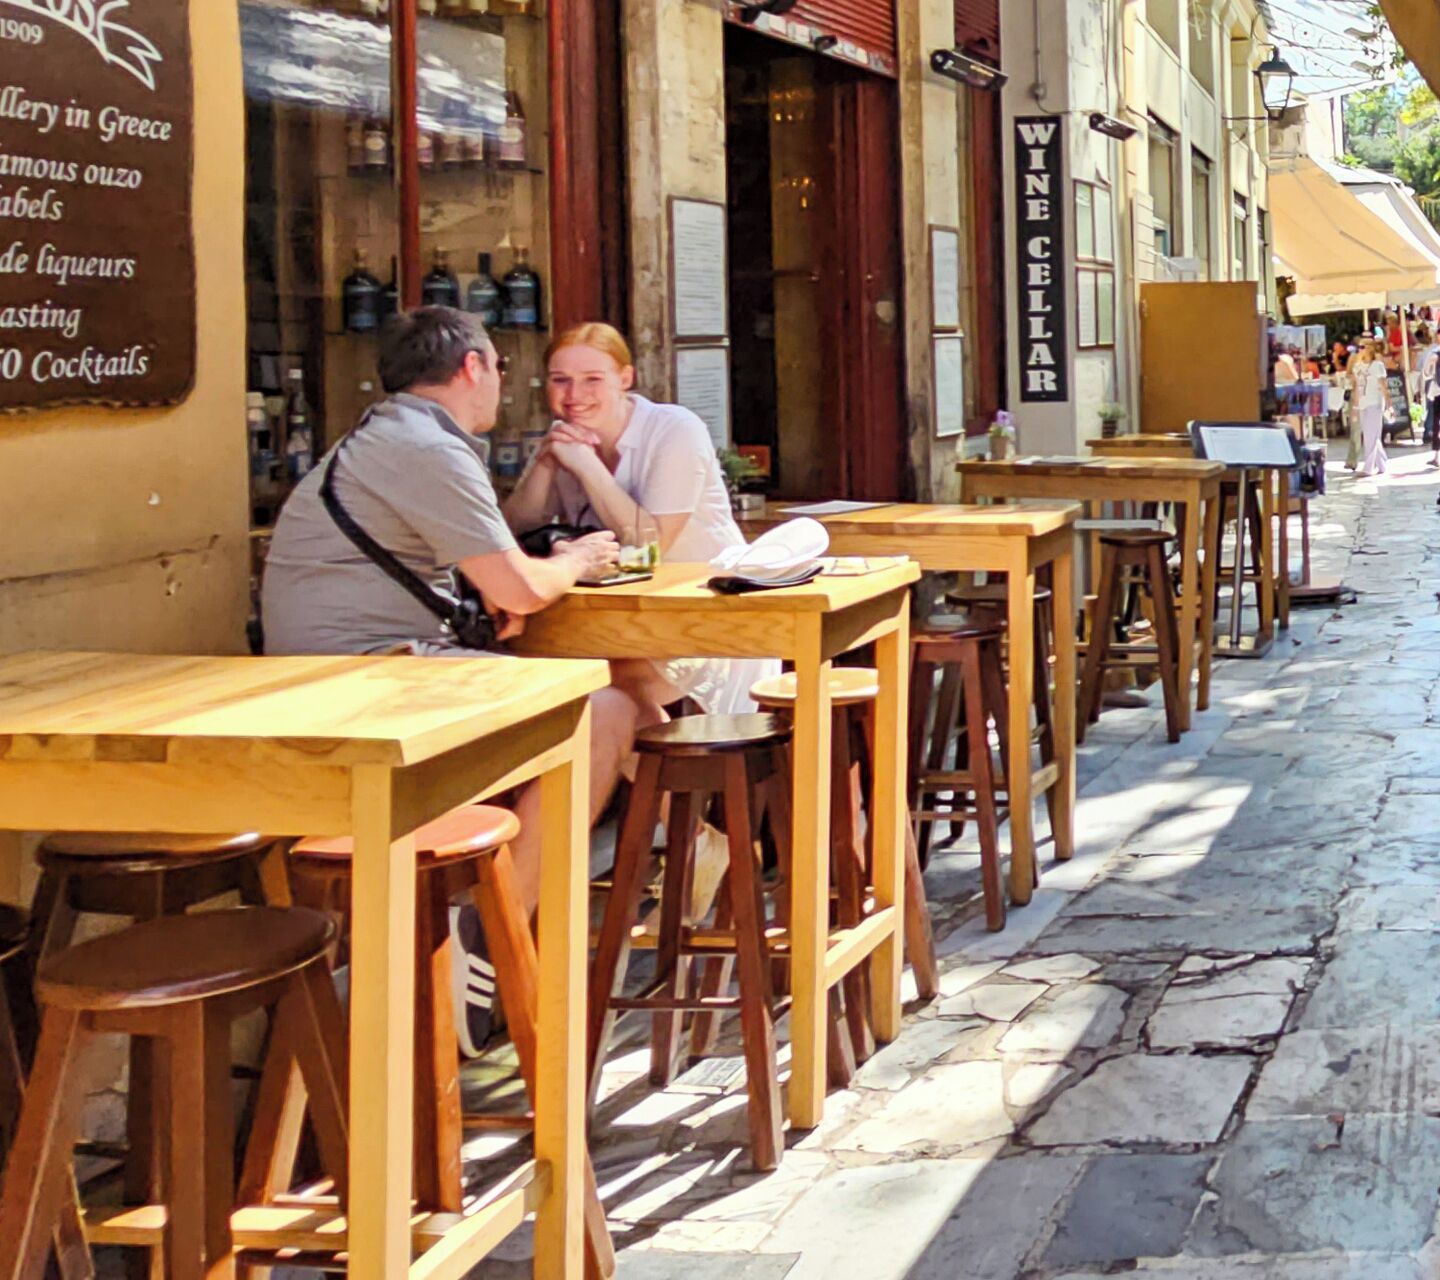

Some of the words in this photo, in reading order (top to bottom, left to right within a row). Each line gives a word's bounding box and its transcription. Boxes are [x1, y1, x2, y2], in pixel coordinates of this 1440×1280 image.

[65, 98, 91, 129] in
[98, 106, 172, 142] Greece
[84, 164, 142, 189] ouzo
[1016, 123, 1056, 221] WINE
[36, 243, 136, 286] liqueurs
[1026, 236, 1057, 392] CELLAR
[31, 345, 149, 384] Cocktails
